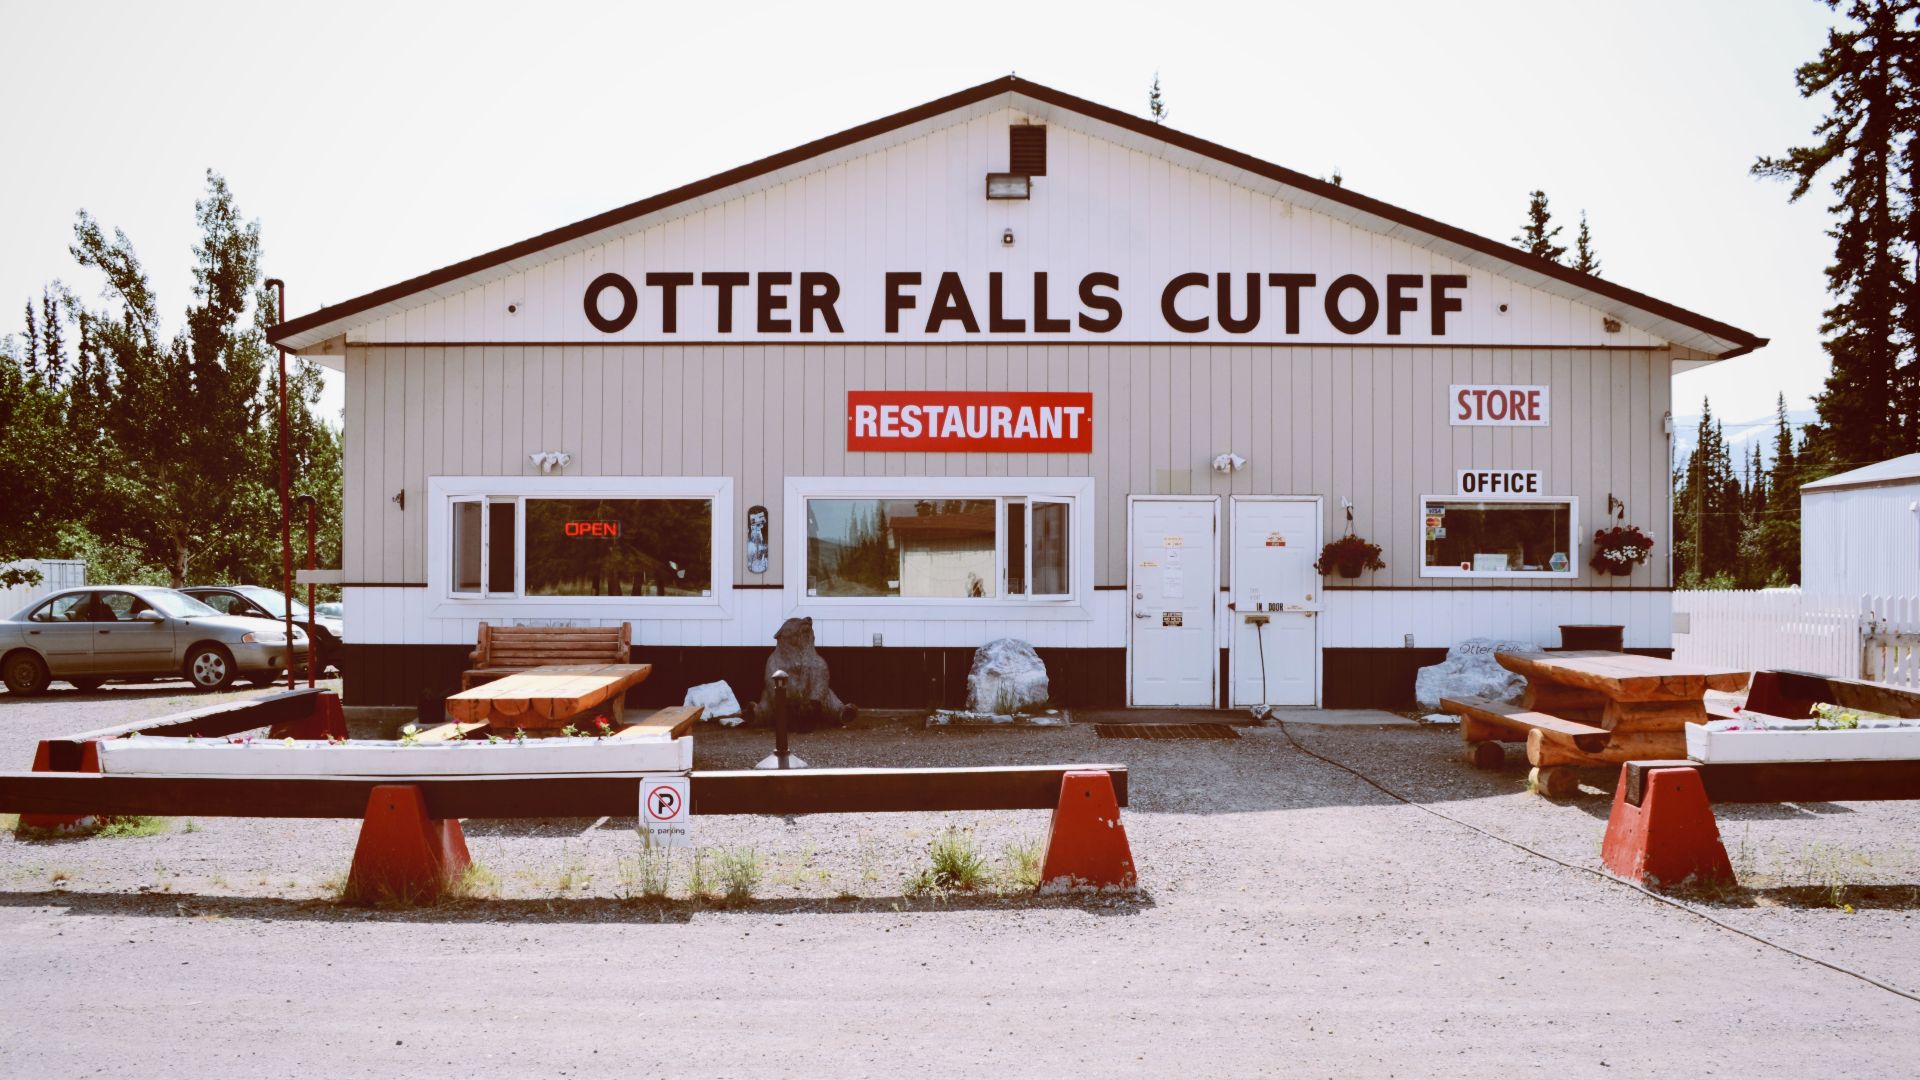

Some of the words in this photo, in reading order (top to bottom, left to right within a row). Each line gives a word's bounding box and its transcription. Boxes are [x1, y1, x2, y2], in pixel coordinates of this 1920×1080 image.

[584, 272, 843, 333] OTTER
[886, 272, 1122, 333] FALLS
[1161, 272, 1468, 335] CUTOFF
[1458, 389, 1540, 420] STORE
[855, 404, 1085, 439] RESTAURANT
[1462, 472, 1538, 493] OFFICE
[564, 522, 618, 536] OPEN
[1459, 643, 1492, 655] Otter
